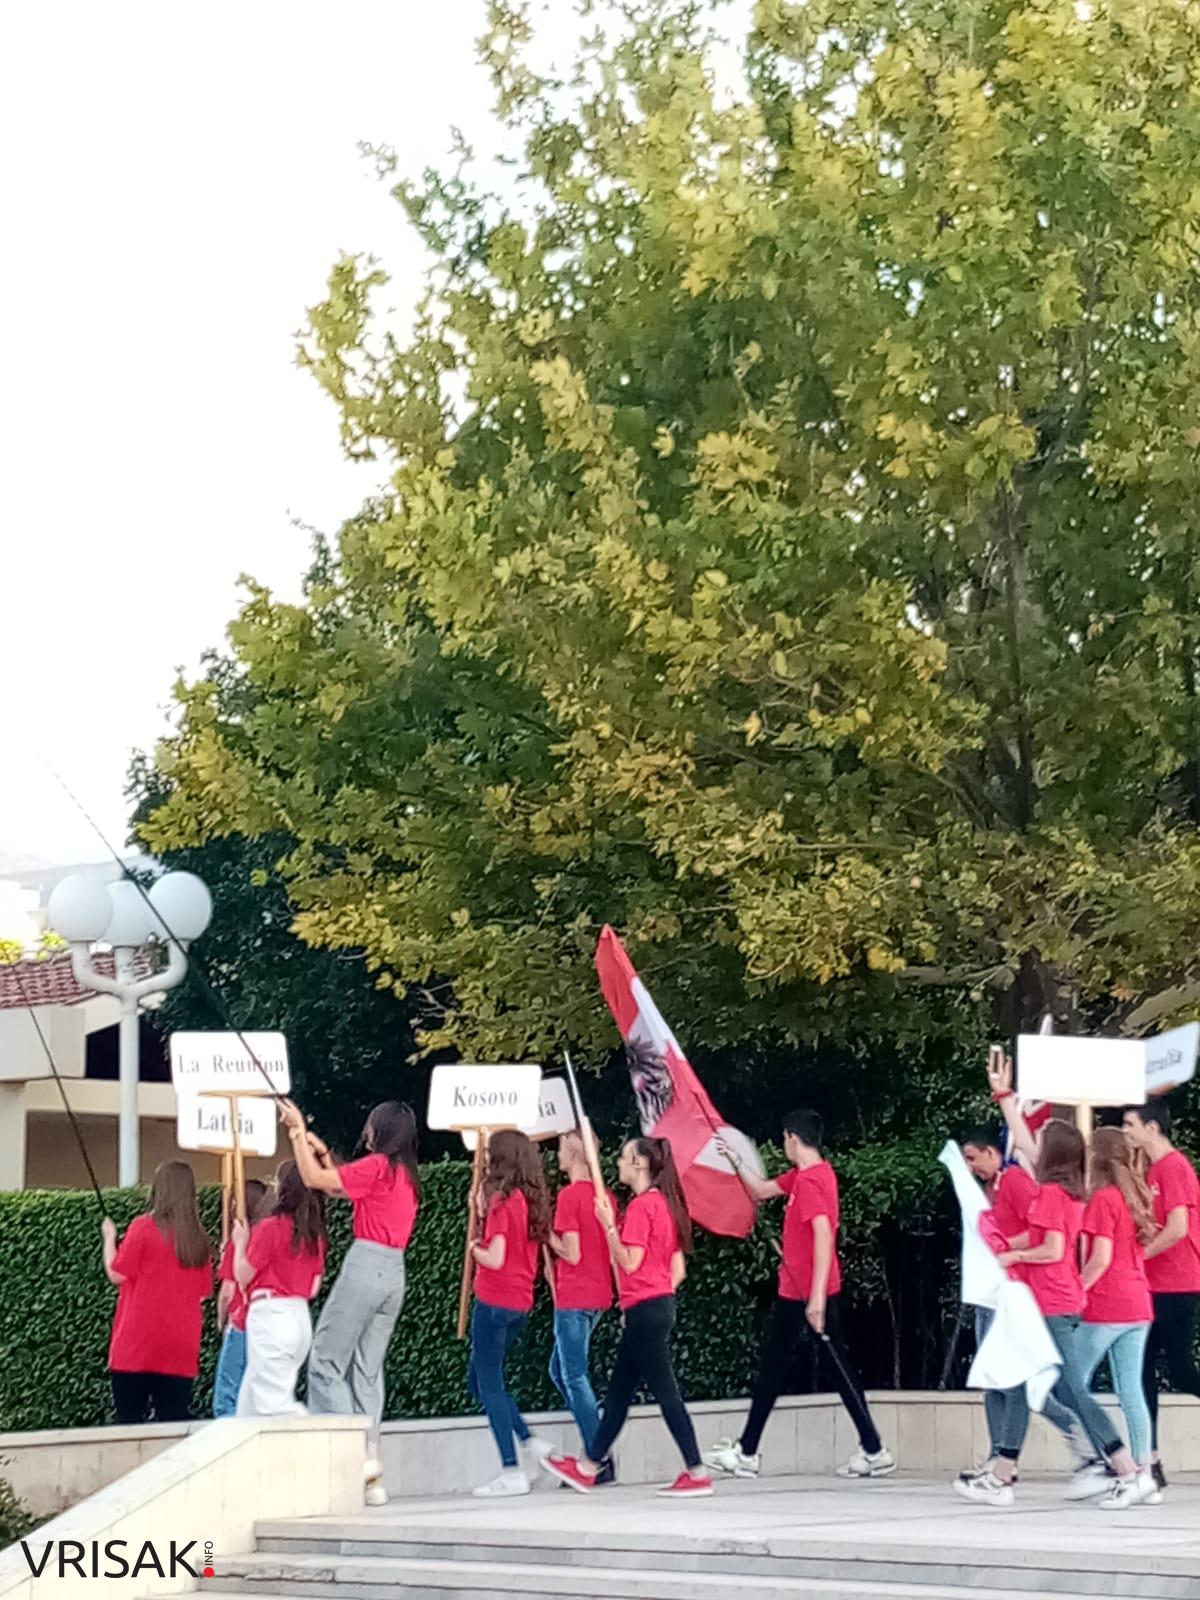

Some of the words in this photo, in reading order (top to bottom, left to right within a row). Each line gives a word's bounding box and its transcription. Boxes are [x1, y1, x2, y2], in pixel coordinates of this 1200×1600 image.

[178, 1054, 200, 1073] La
[452, 1085, 518, 1108] Kosovo
[196, 1107, 254, 1135] Latia
